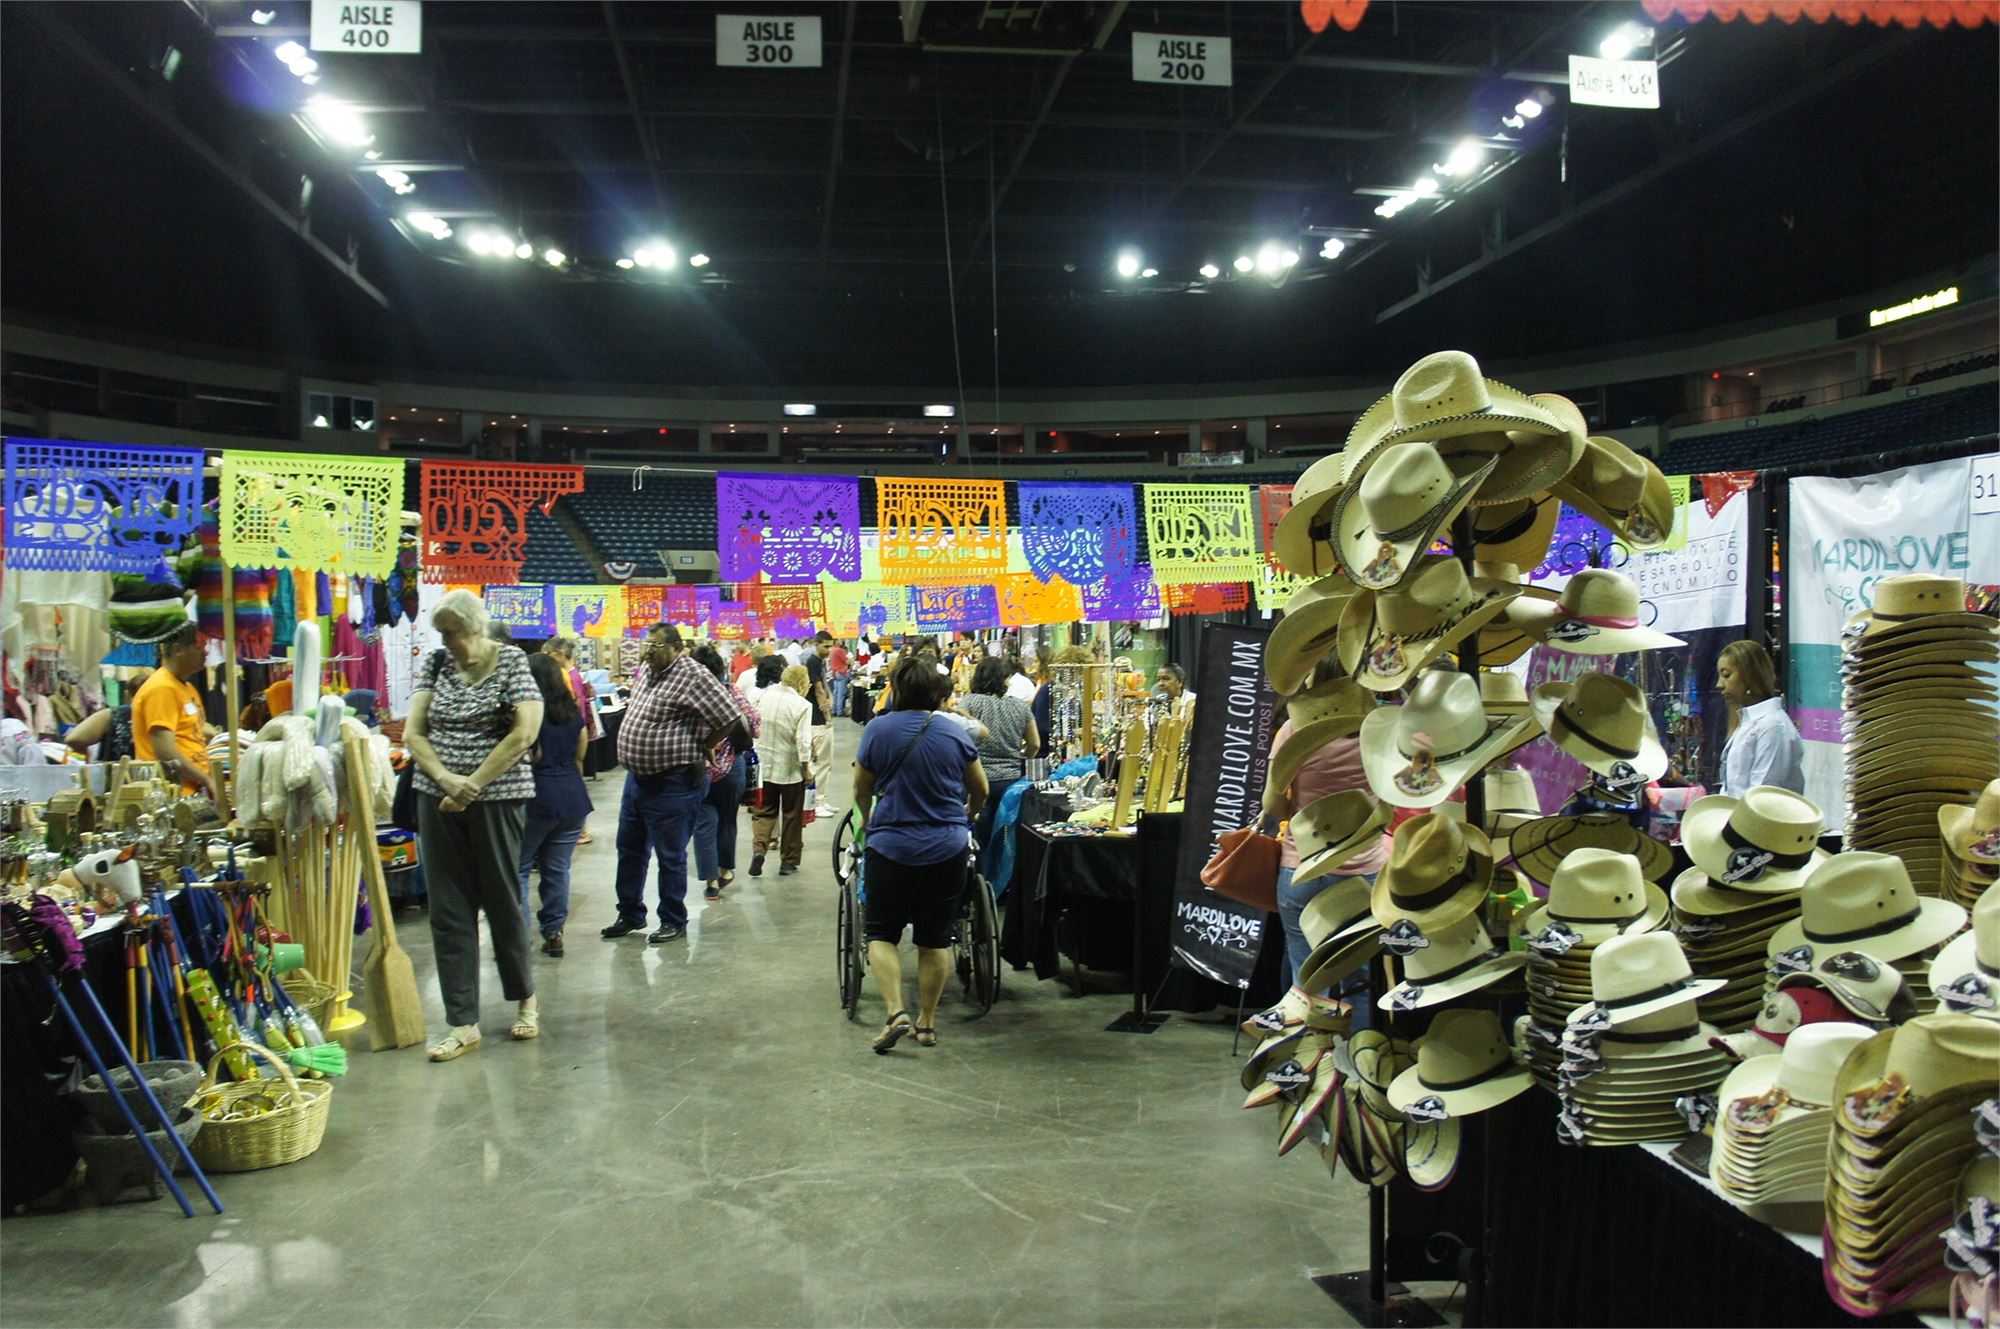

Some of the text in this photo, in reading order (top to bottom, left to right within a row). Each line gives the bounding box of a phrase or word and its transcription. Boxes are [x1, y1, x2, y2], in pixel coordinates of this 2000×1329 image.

[340, 5, 394, 26] AISLE
[342, 29, 390, 48] 400
[743, 21, 796, 42] AISLE
[746, 44, 793, 64] 300
[1157, 39, 1207, 61] AISLE
[1161, 63, 1205, 82] 200
[1576, 70, 1614, 94] Aise
[1251, 758, 1267, 793] LUIS
[1177, 901, 1262, 937] MARDILOVE
